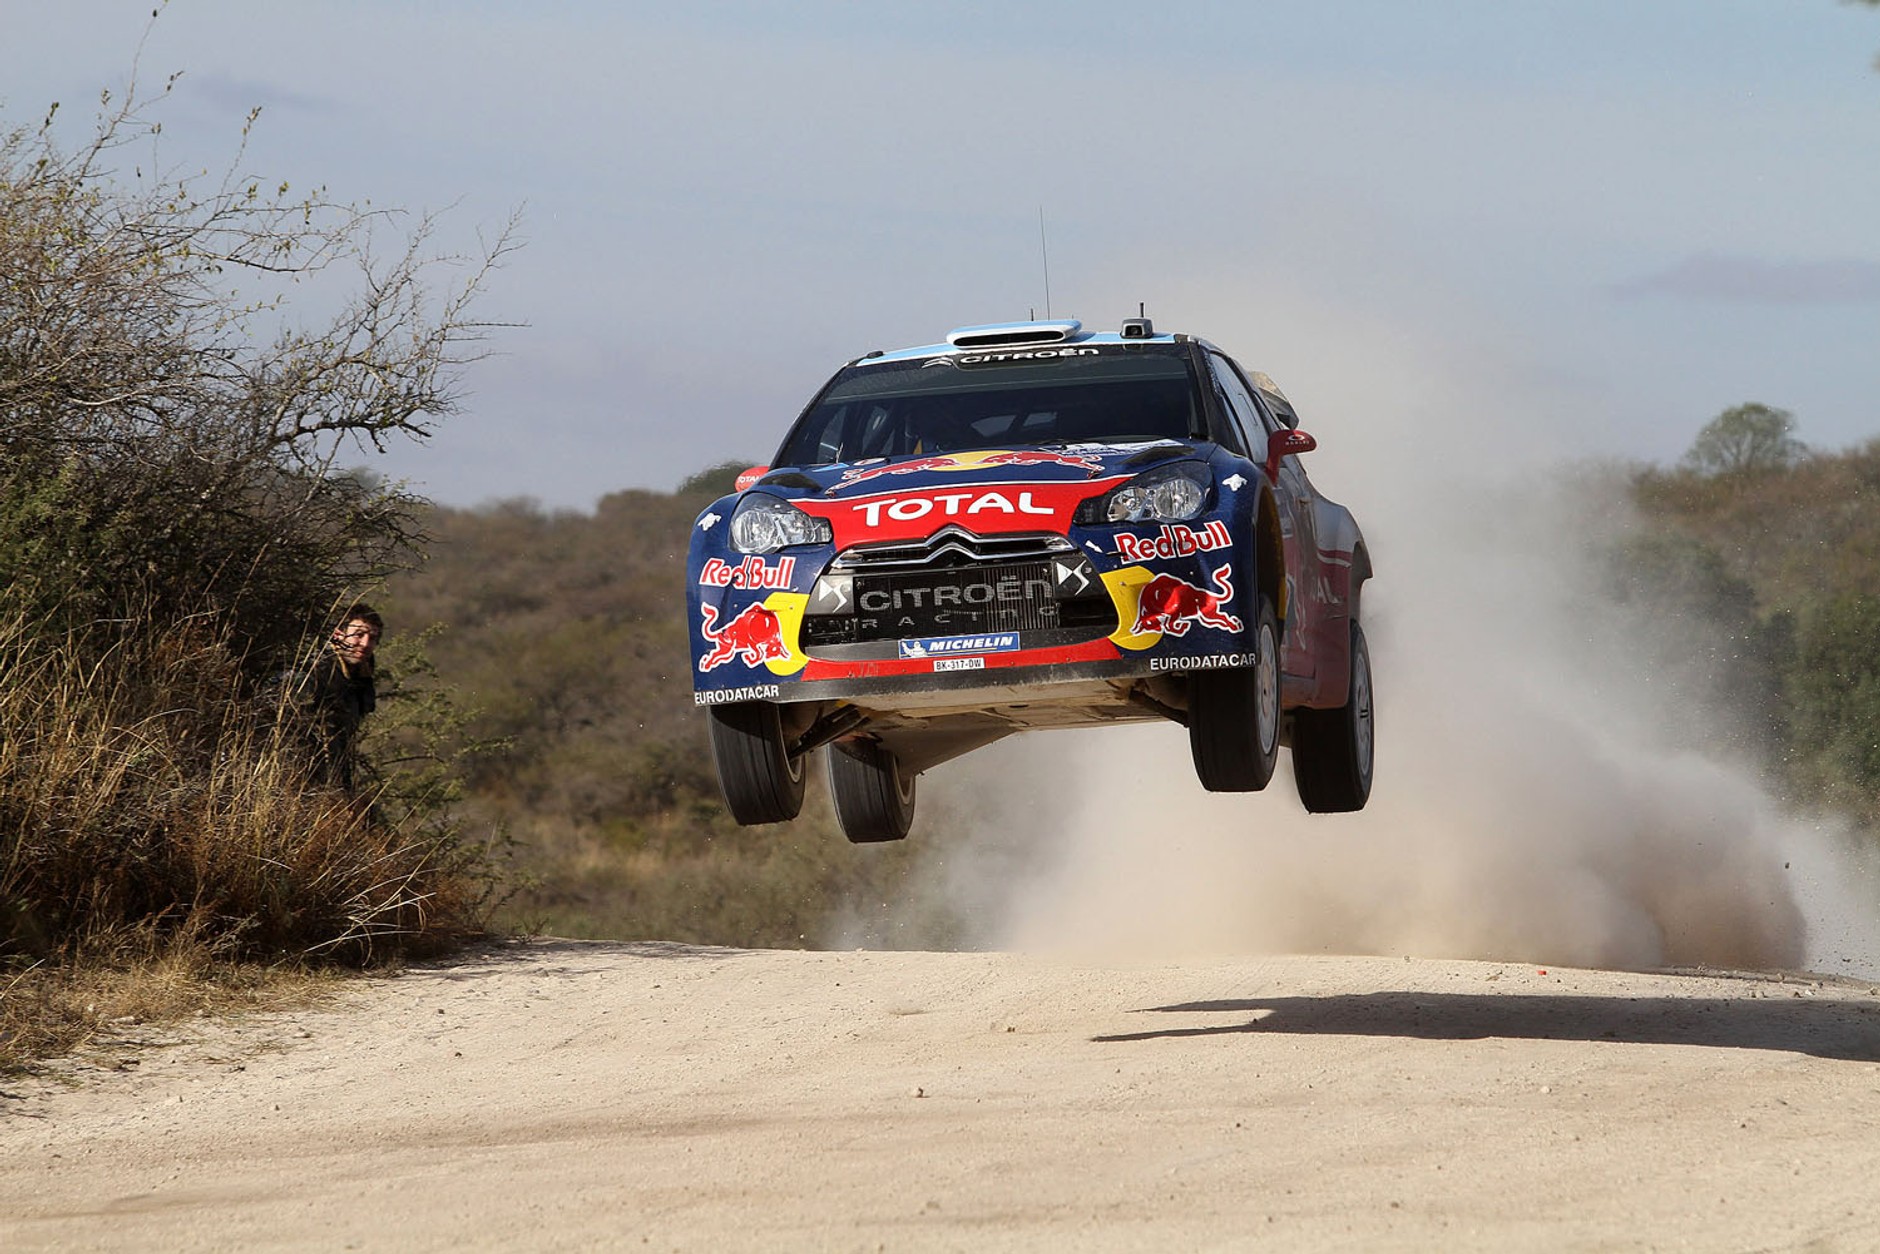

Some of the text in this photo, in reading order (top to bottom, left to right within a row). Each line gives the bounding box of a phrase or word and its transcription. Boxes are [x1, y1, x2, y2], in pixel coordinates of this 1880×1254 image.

[853, 492, 1054, 527] TOTAL
[929, 636, 1014, 651] MICHELIN
[936, 659, 982, 670] BK-317-DW
[1150, 653, 1256, 671] EURODATACAR
[694, 685, 779, 705] EURODATACAR
